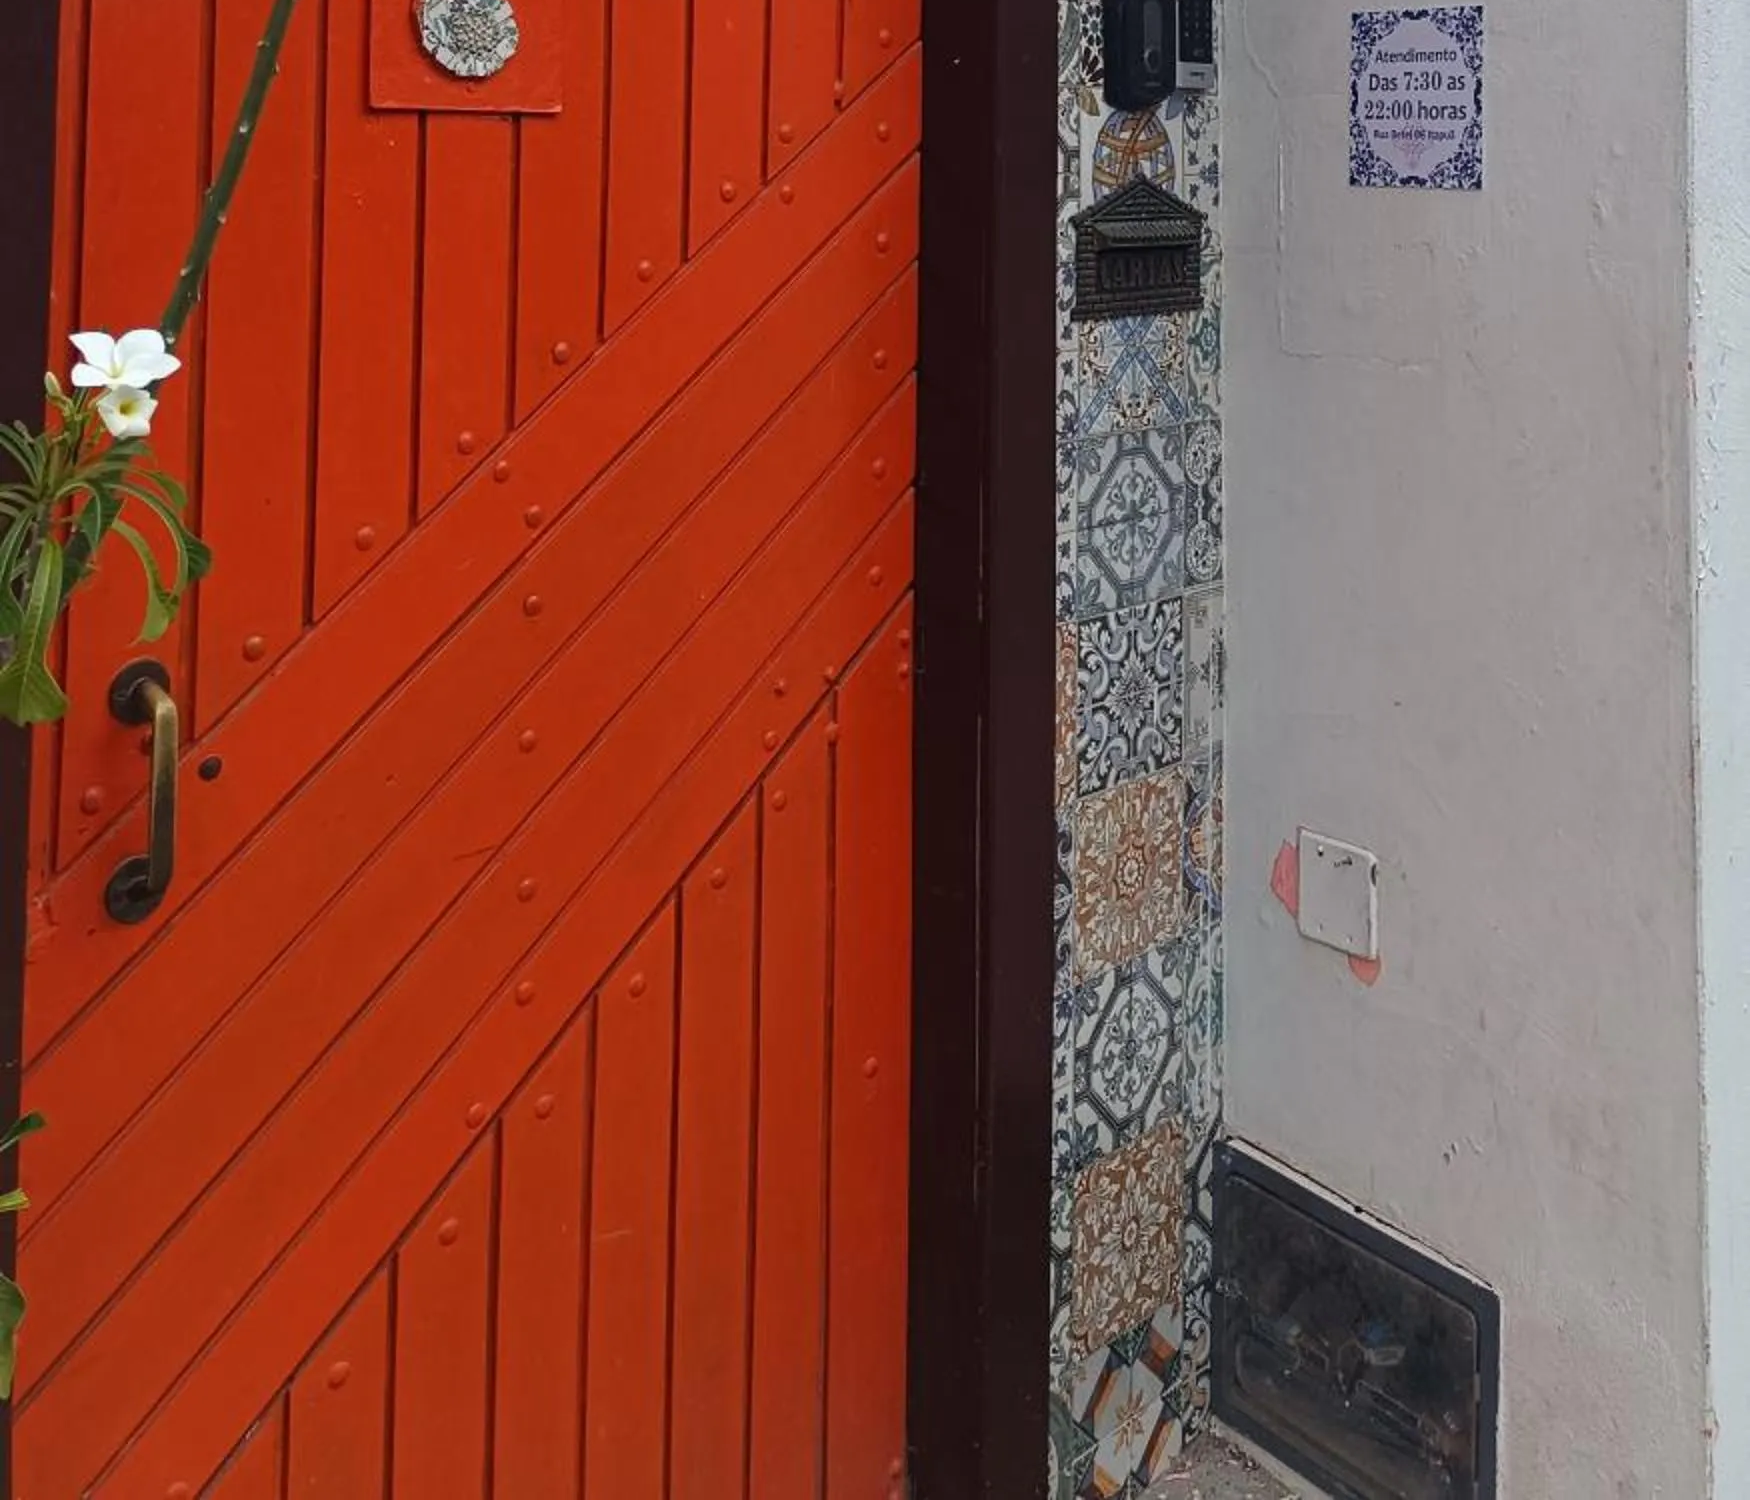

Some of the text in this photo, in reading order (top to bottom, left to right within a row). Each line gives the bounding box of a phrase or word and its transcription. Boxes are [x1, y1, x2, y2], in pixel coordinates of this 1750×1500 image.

[1375, 49, 1457, 63] Atendimento
[1369, 73, 1398, 91] Das
[1403, 70, 1442, 91] 7:30
[1364, 100, 1467, 120] 22:00 horas
